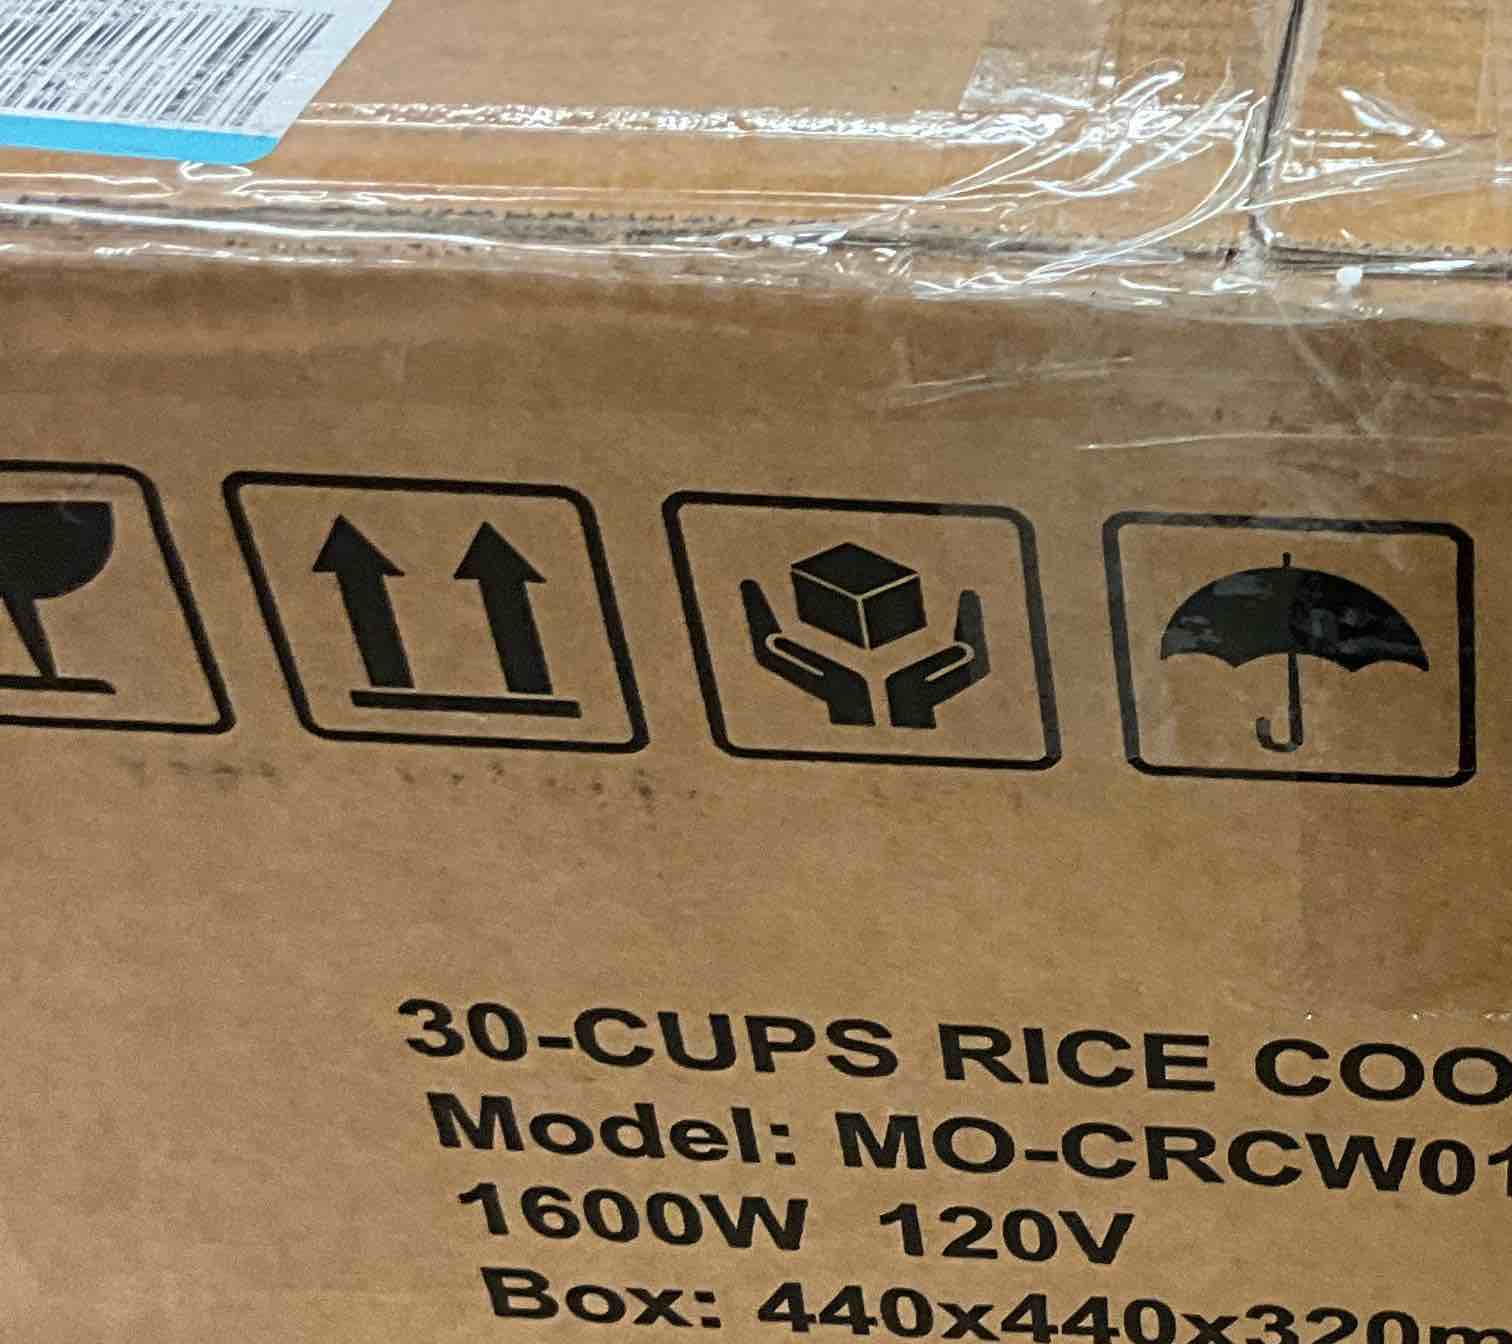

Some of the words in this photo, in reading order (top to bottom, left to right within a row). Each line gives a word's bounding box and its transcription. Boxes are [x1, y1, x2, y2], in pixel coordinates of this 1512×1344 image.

[398, 998, 898, 1078] 30-CUPS
[938, 1023, 1216, 1093] RICE
[426, 1091, 796, 1166] Model:
[458, 1182, 809, 1251] 1600W
[879, 1203, 1135, 1265] 120V
[479, 1266, 722, 1329] Box:
